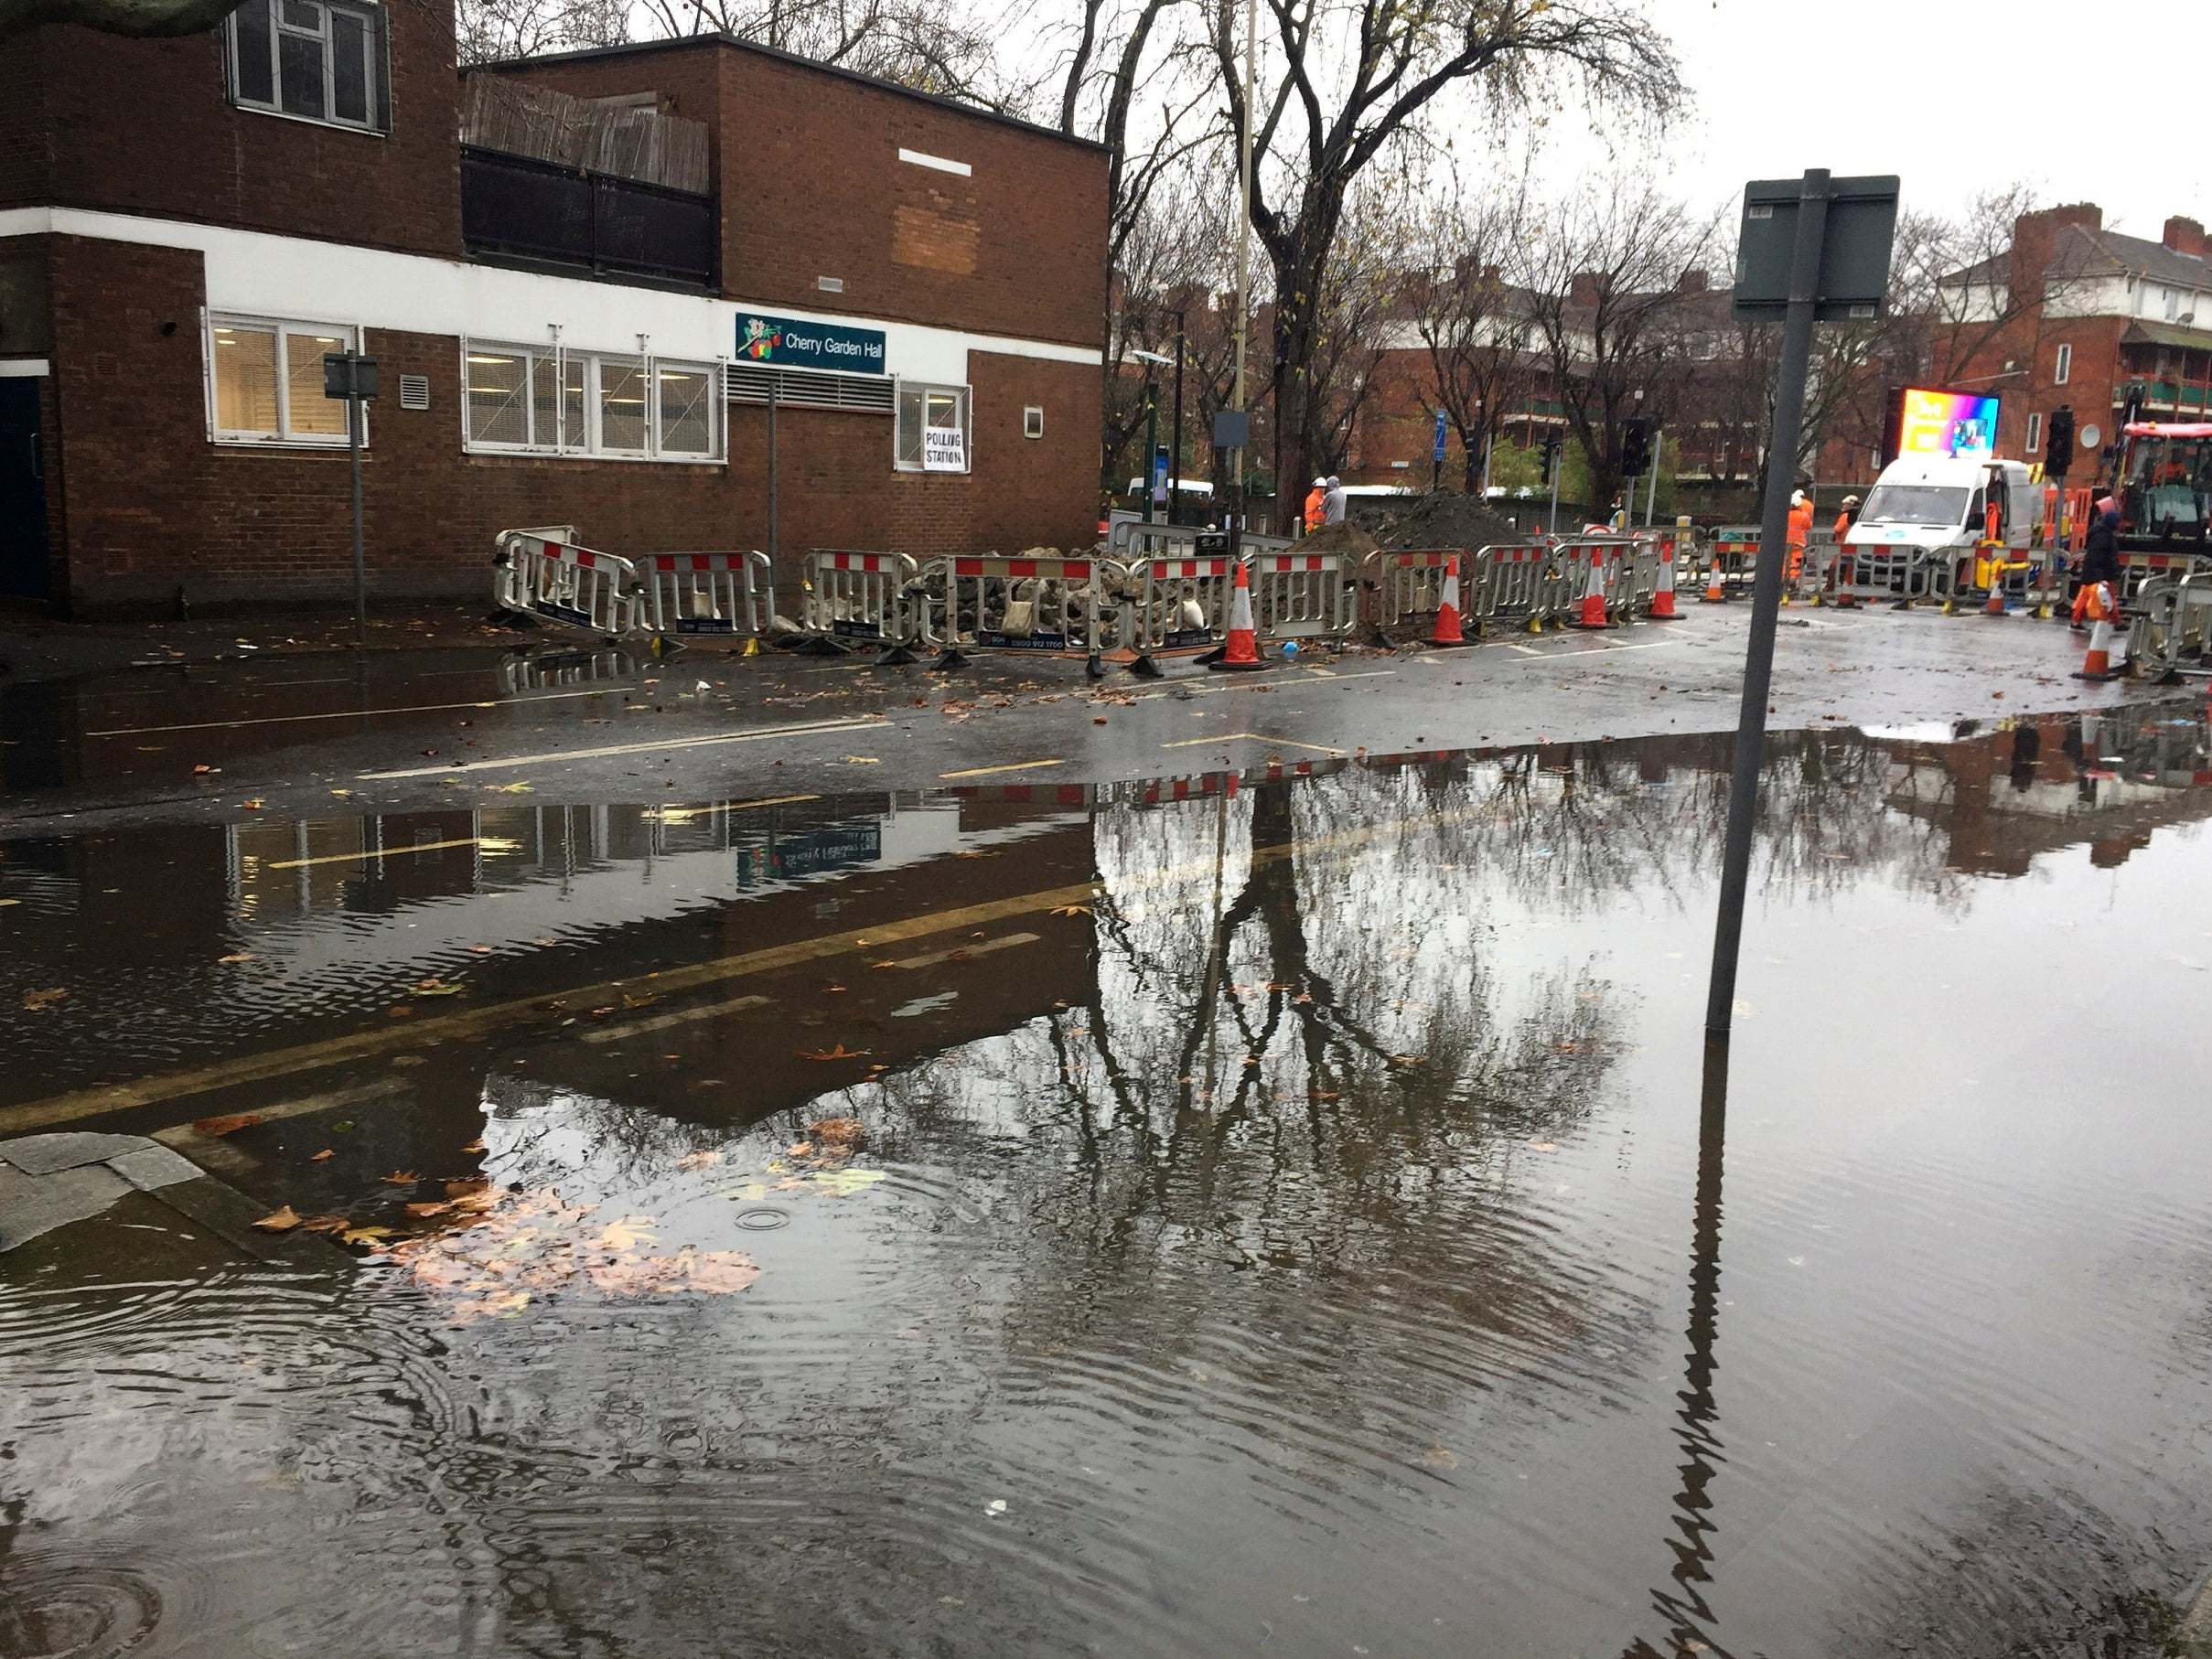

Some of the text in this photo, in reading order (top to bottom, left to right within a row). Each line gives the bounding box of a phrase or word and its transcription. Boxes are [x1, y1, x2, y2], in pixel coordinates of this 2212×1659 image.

[786, 332, 883, 359] Cherry Garden Hall
[926, 433, 961, 446] POLLING
[927, 450, 961, 464] STATION
